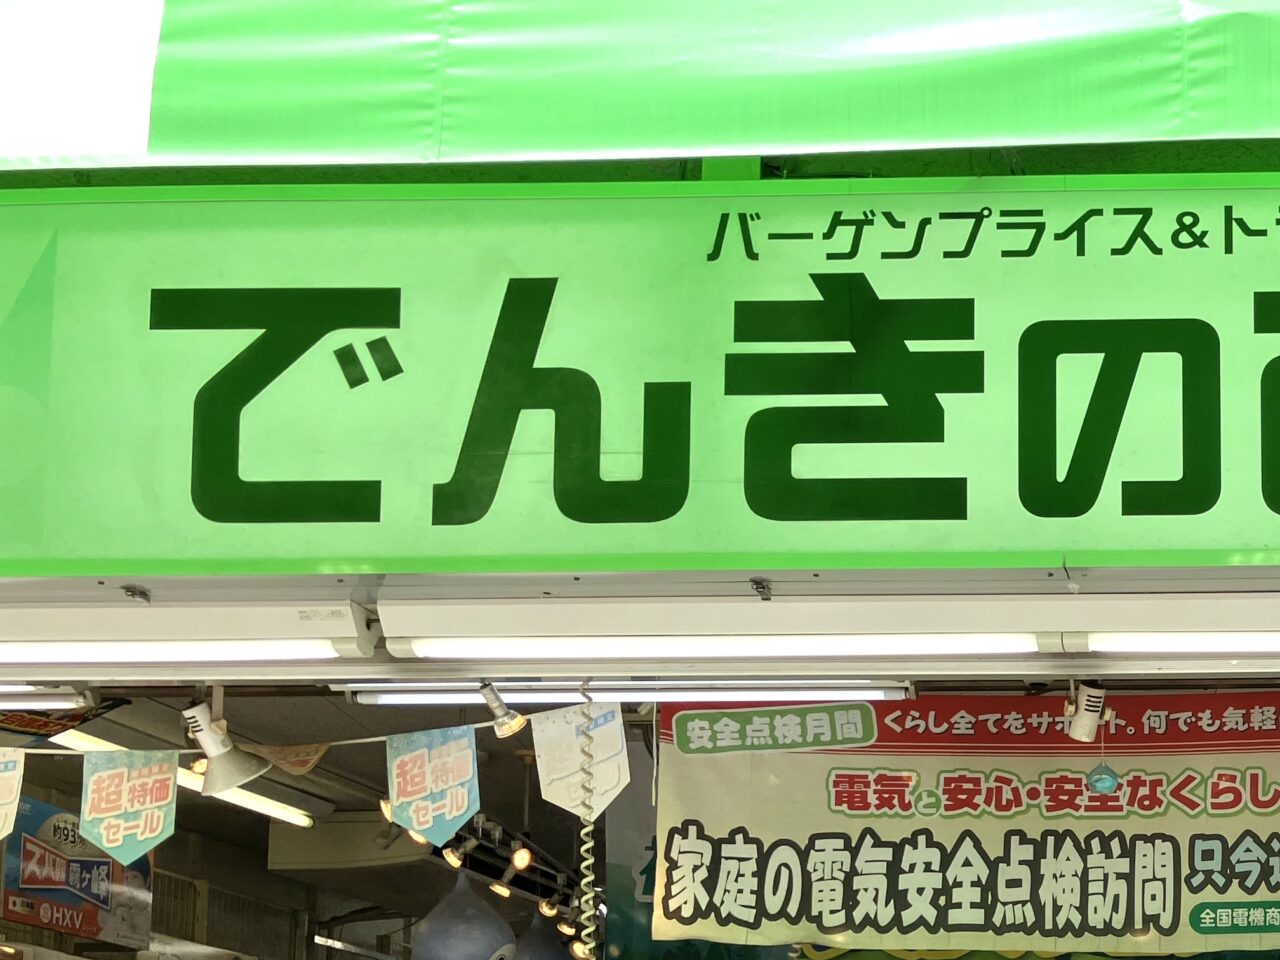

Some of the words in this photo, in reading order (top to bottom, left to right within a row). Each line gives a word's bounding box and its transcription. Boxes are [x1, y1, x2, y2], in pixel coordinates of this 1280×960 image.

[687, 710, 863, 749] 安全点検月間
[89, 771, 171, 816] 超特価
[396, 753, 470, 799] 超特価
[104, 810, 160, 844] セール
[412, 790, 463, 825] セール
[666, 822, 1178, 933] 家庭の電気安全点検訪問
[52, 905, 83, 929] HXV
